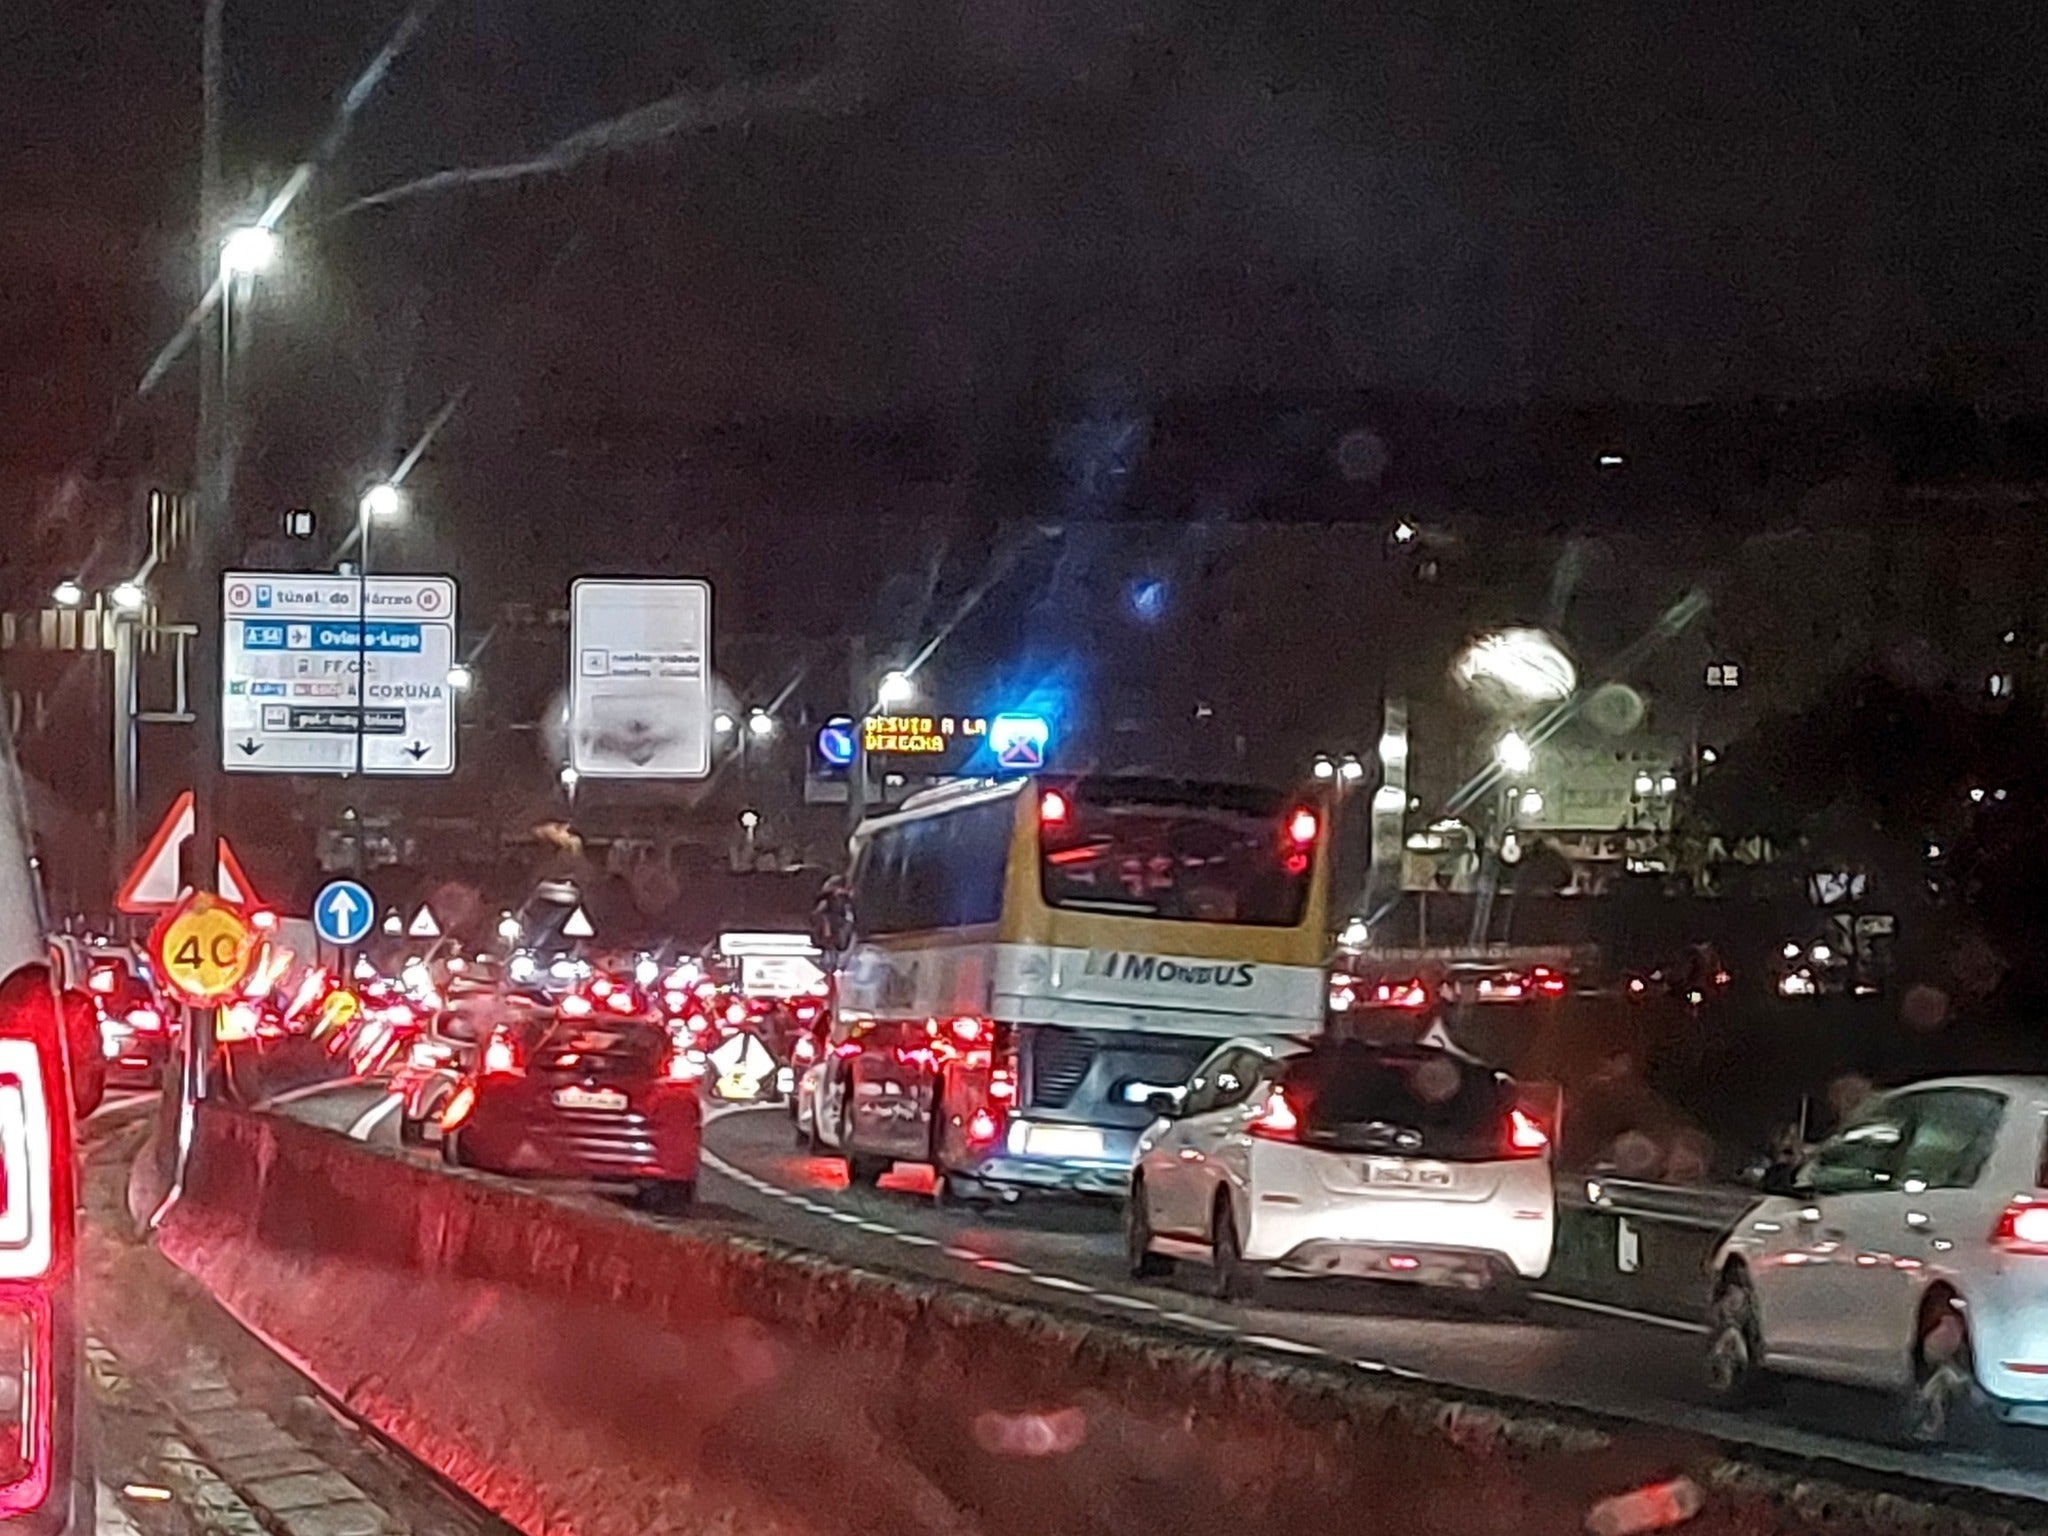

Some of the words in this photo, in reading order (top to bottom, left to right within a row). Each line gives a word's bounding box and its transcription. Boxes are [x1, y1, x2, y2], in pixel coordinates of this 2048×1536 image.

[330, 591, 349, 604] do
[941, 718, 954, 734] A
[962, 717, 987, 736] LA
